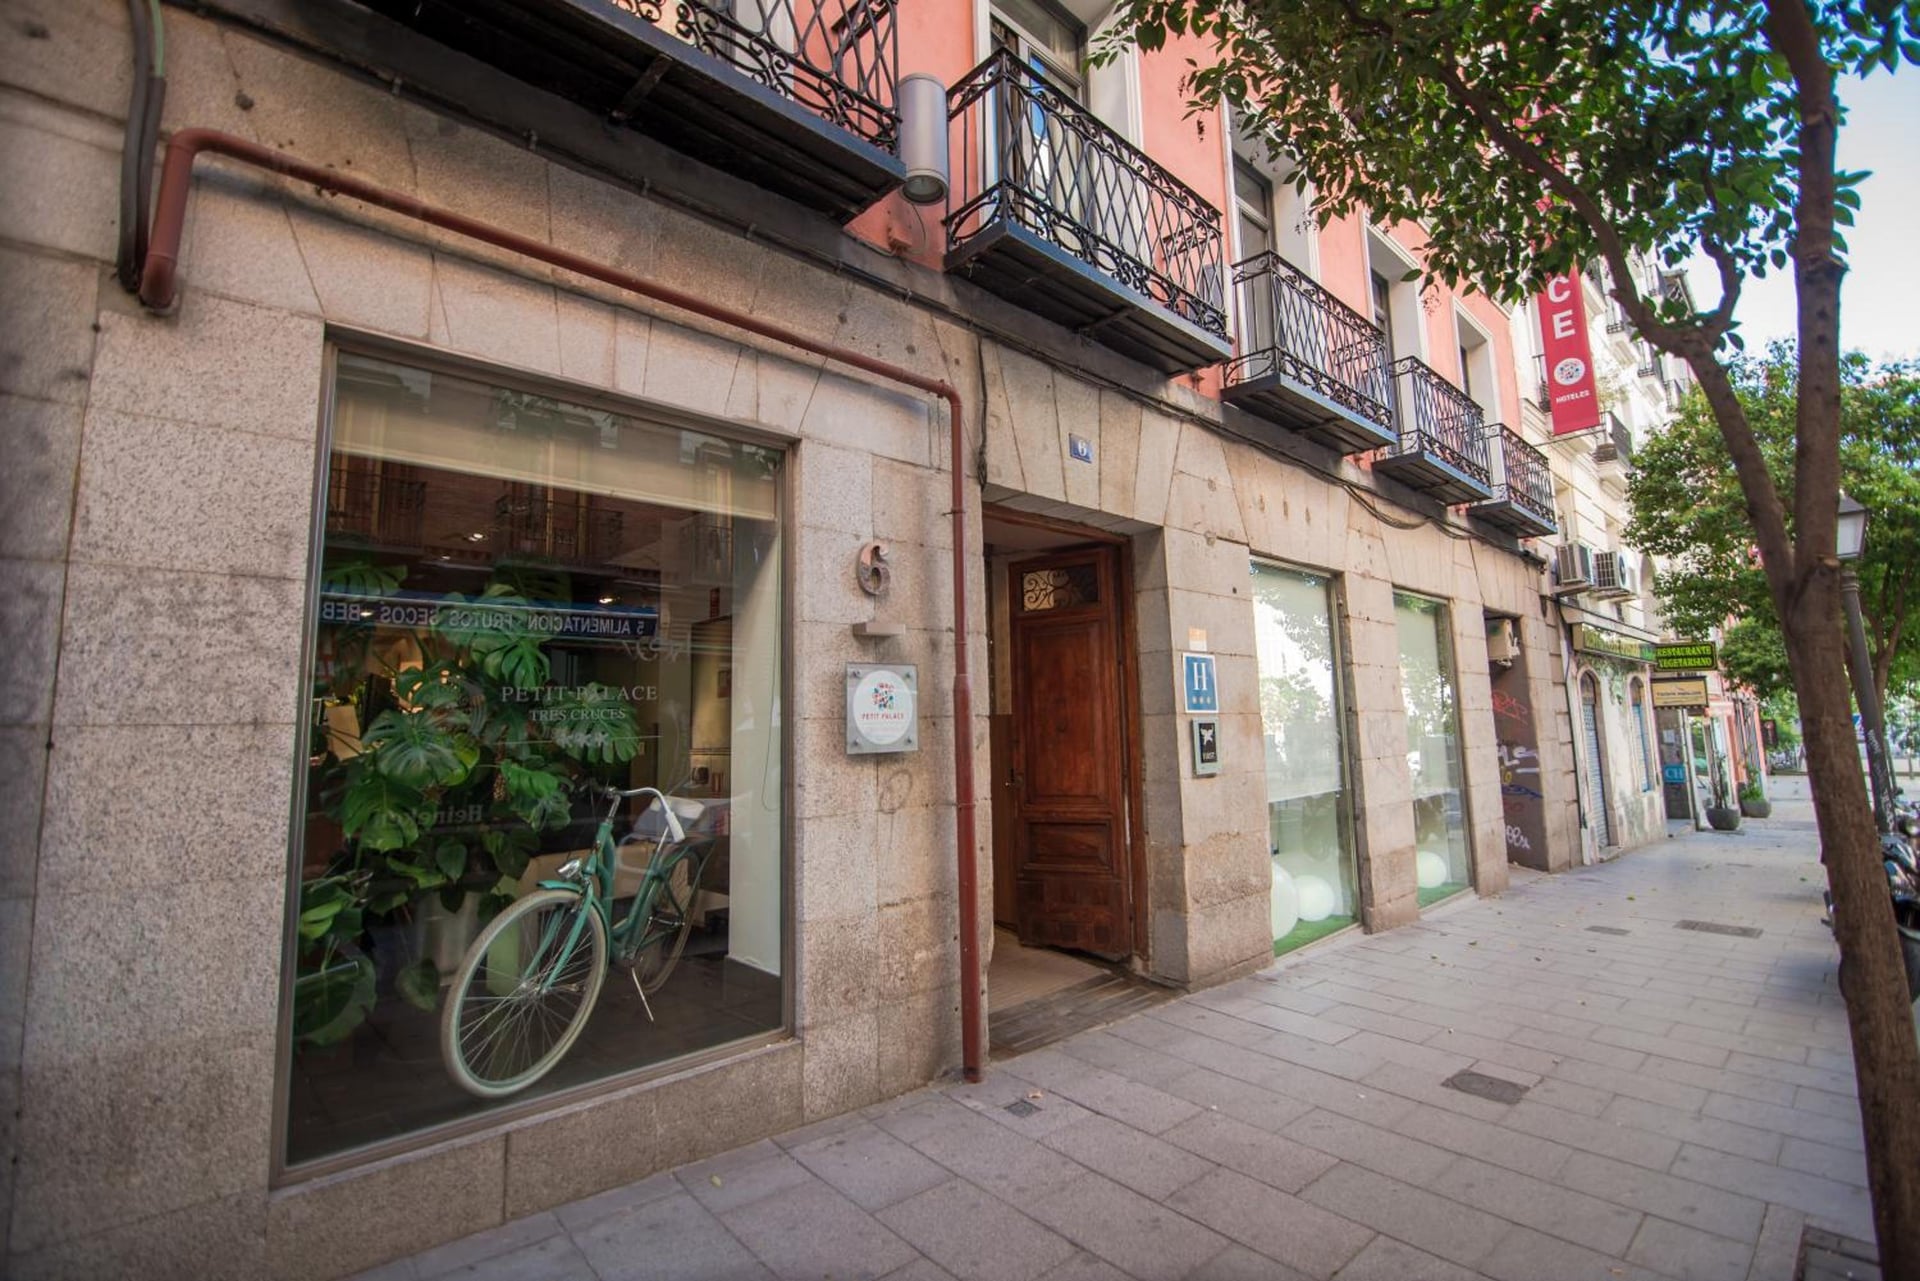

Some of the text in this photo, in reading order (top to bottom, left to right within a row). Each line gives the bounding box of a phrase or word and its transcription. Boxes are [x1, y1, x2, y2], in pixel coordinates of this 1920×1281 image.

[1555, 390, 1591, 404] HOTELES
[1078, 440, 1087, 456] 6
[1657, 645, 1712, 657] RESTAURANTE
[1193, 662, 1208, 691] H
[502, 685, 658, 702] PETIT PALACE
[529, 707, 627, 722] TRES CRUCES
[862, 712, 905, 720] PETIT PALACE
